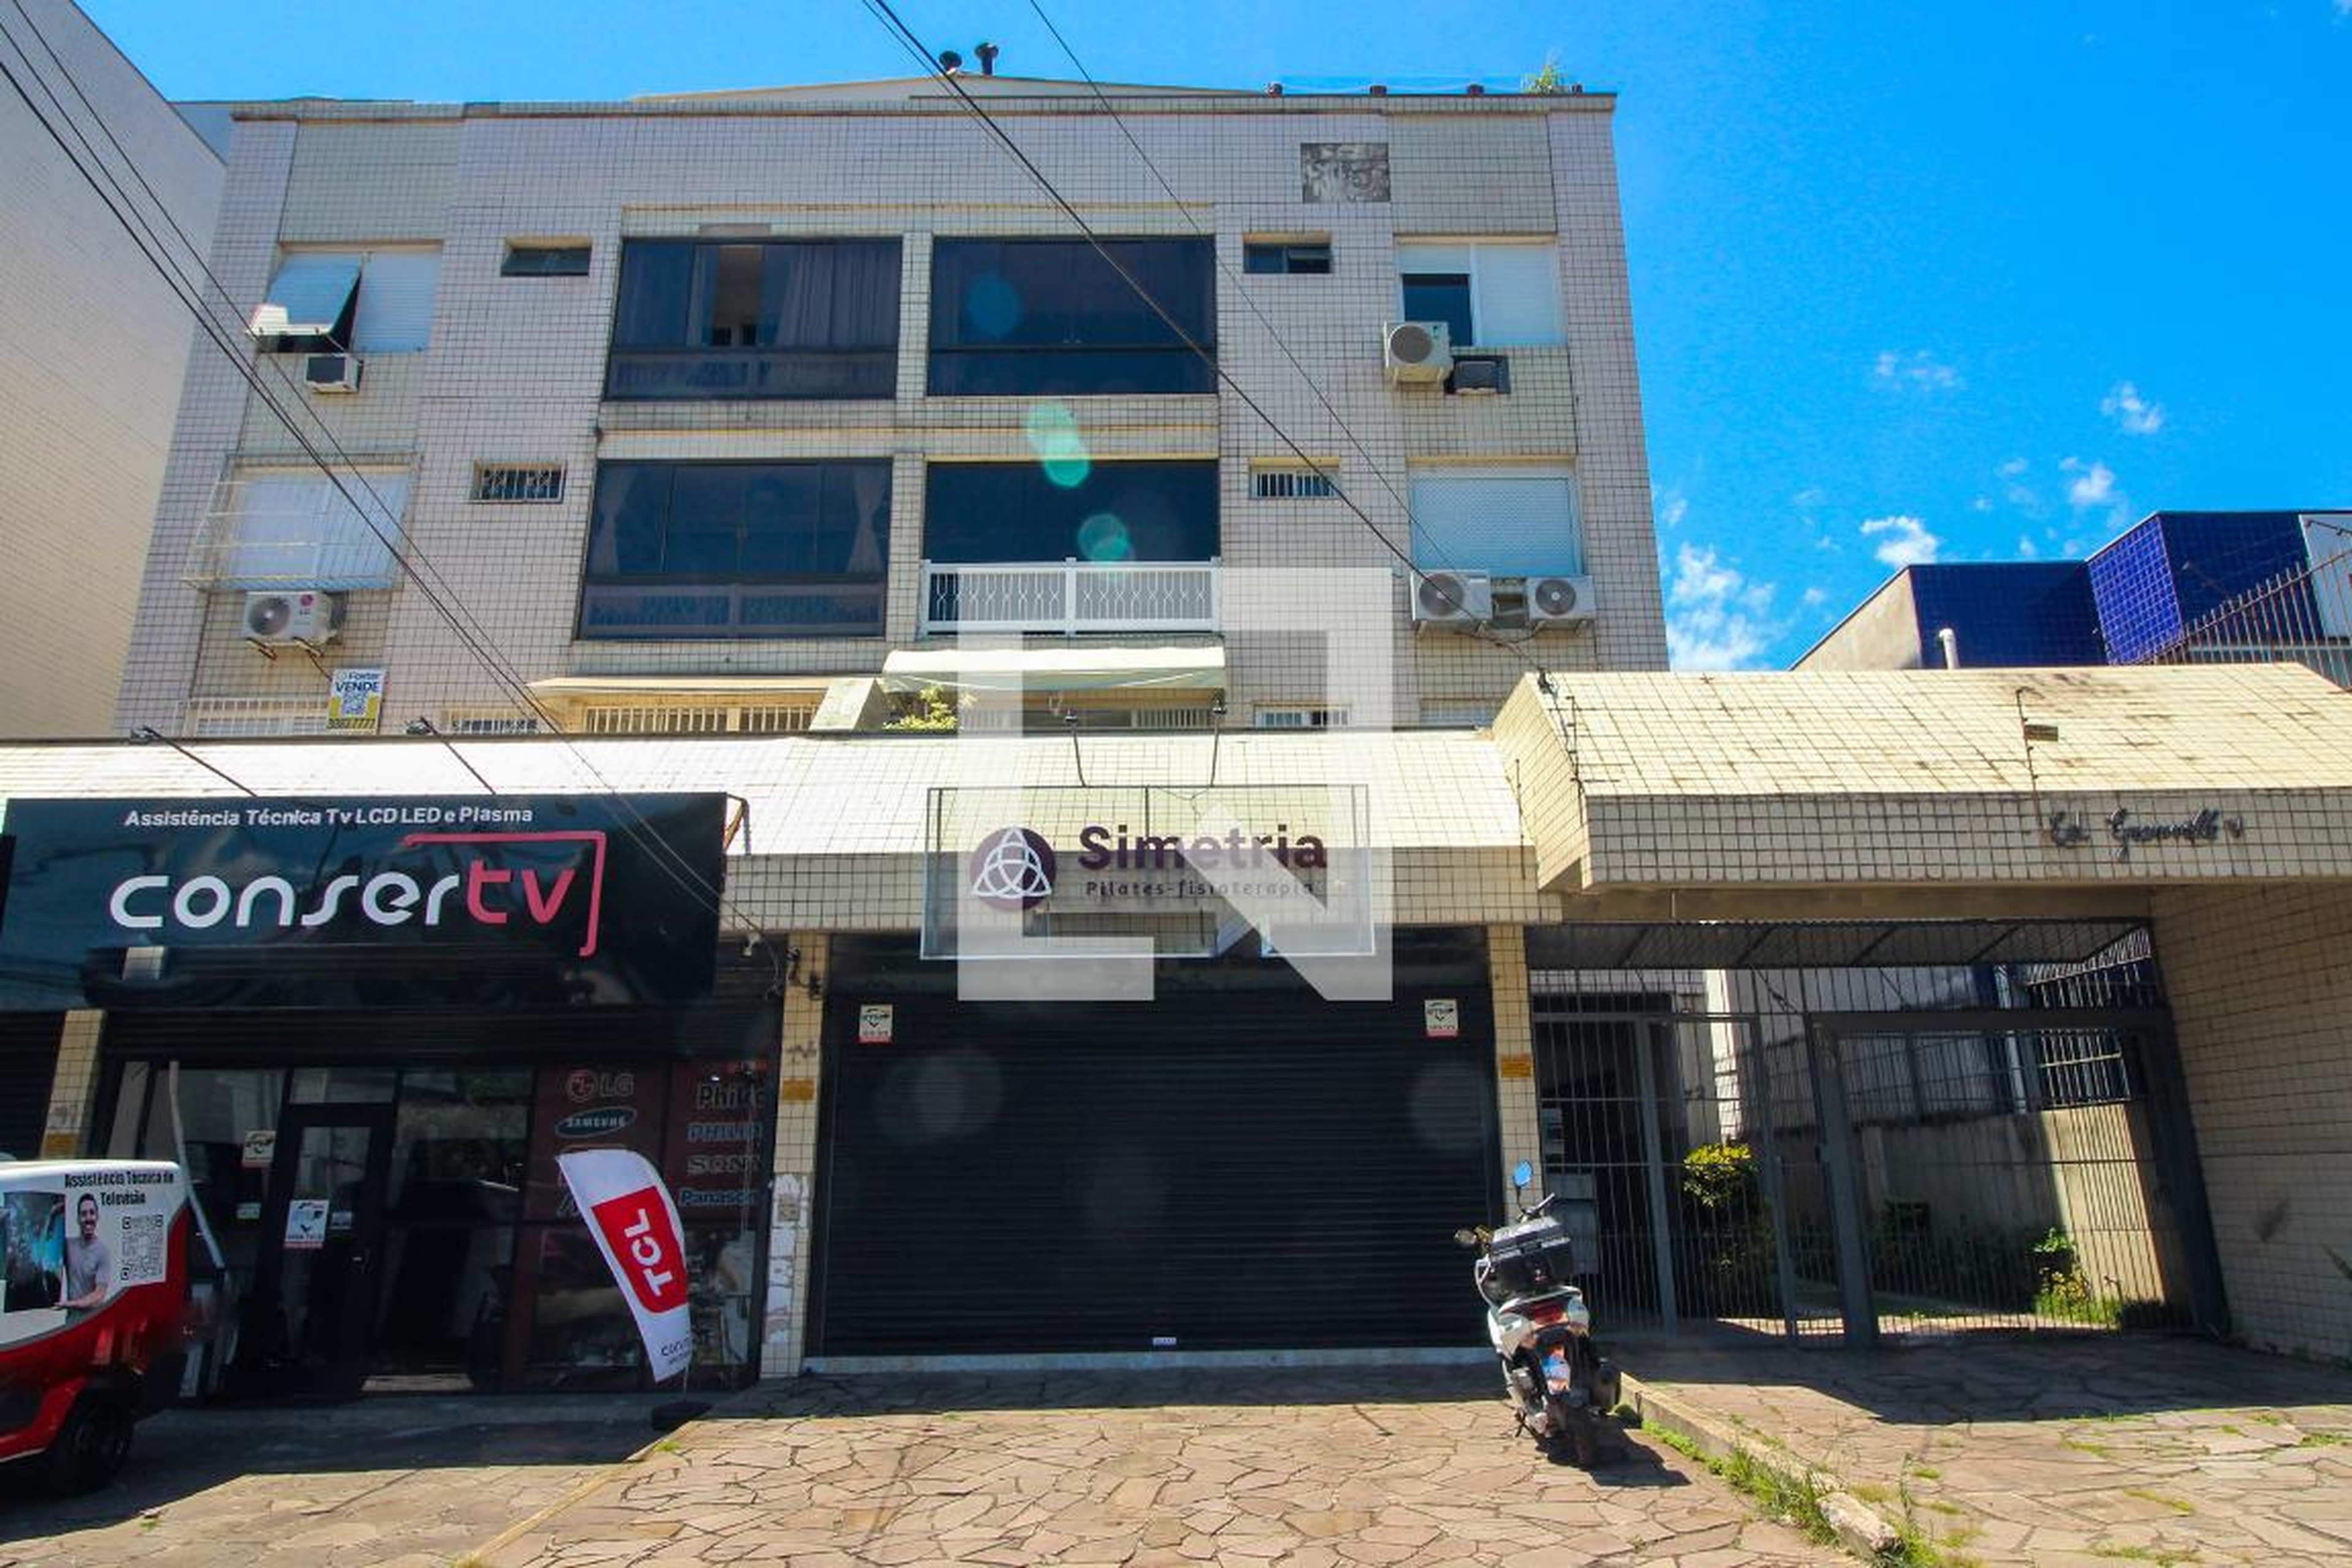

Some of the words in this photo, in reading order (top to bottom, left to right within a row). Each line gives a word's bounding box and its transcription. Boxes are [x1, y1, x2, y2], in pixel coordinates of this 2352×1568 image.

[336, 680, 380, 692] VENDE
[124, 809, 240, 826] Assistência
[246, 808, 322, 826] Técnica
[326, 808, 353, 824] Tv
[355, 807, 399, 824] LCD
[400, 807, 442, 824] LED
[444, 811, 456, 823] e
[459, 806, 533, 823] Plasma
[1078, 824, 1328, 870] Simetria
[599, 1072, 635, 1098] LG
[565, 1115, 626, 1128] SAMSUNG
[624, 1207, 673, 1297] TCL
